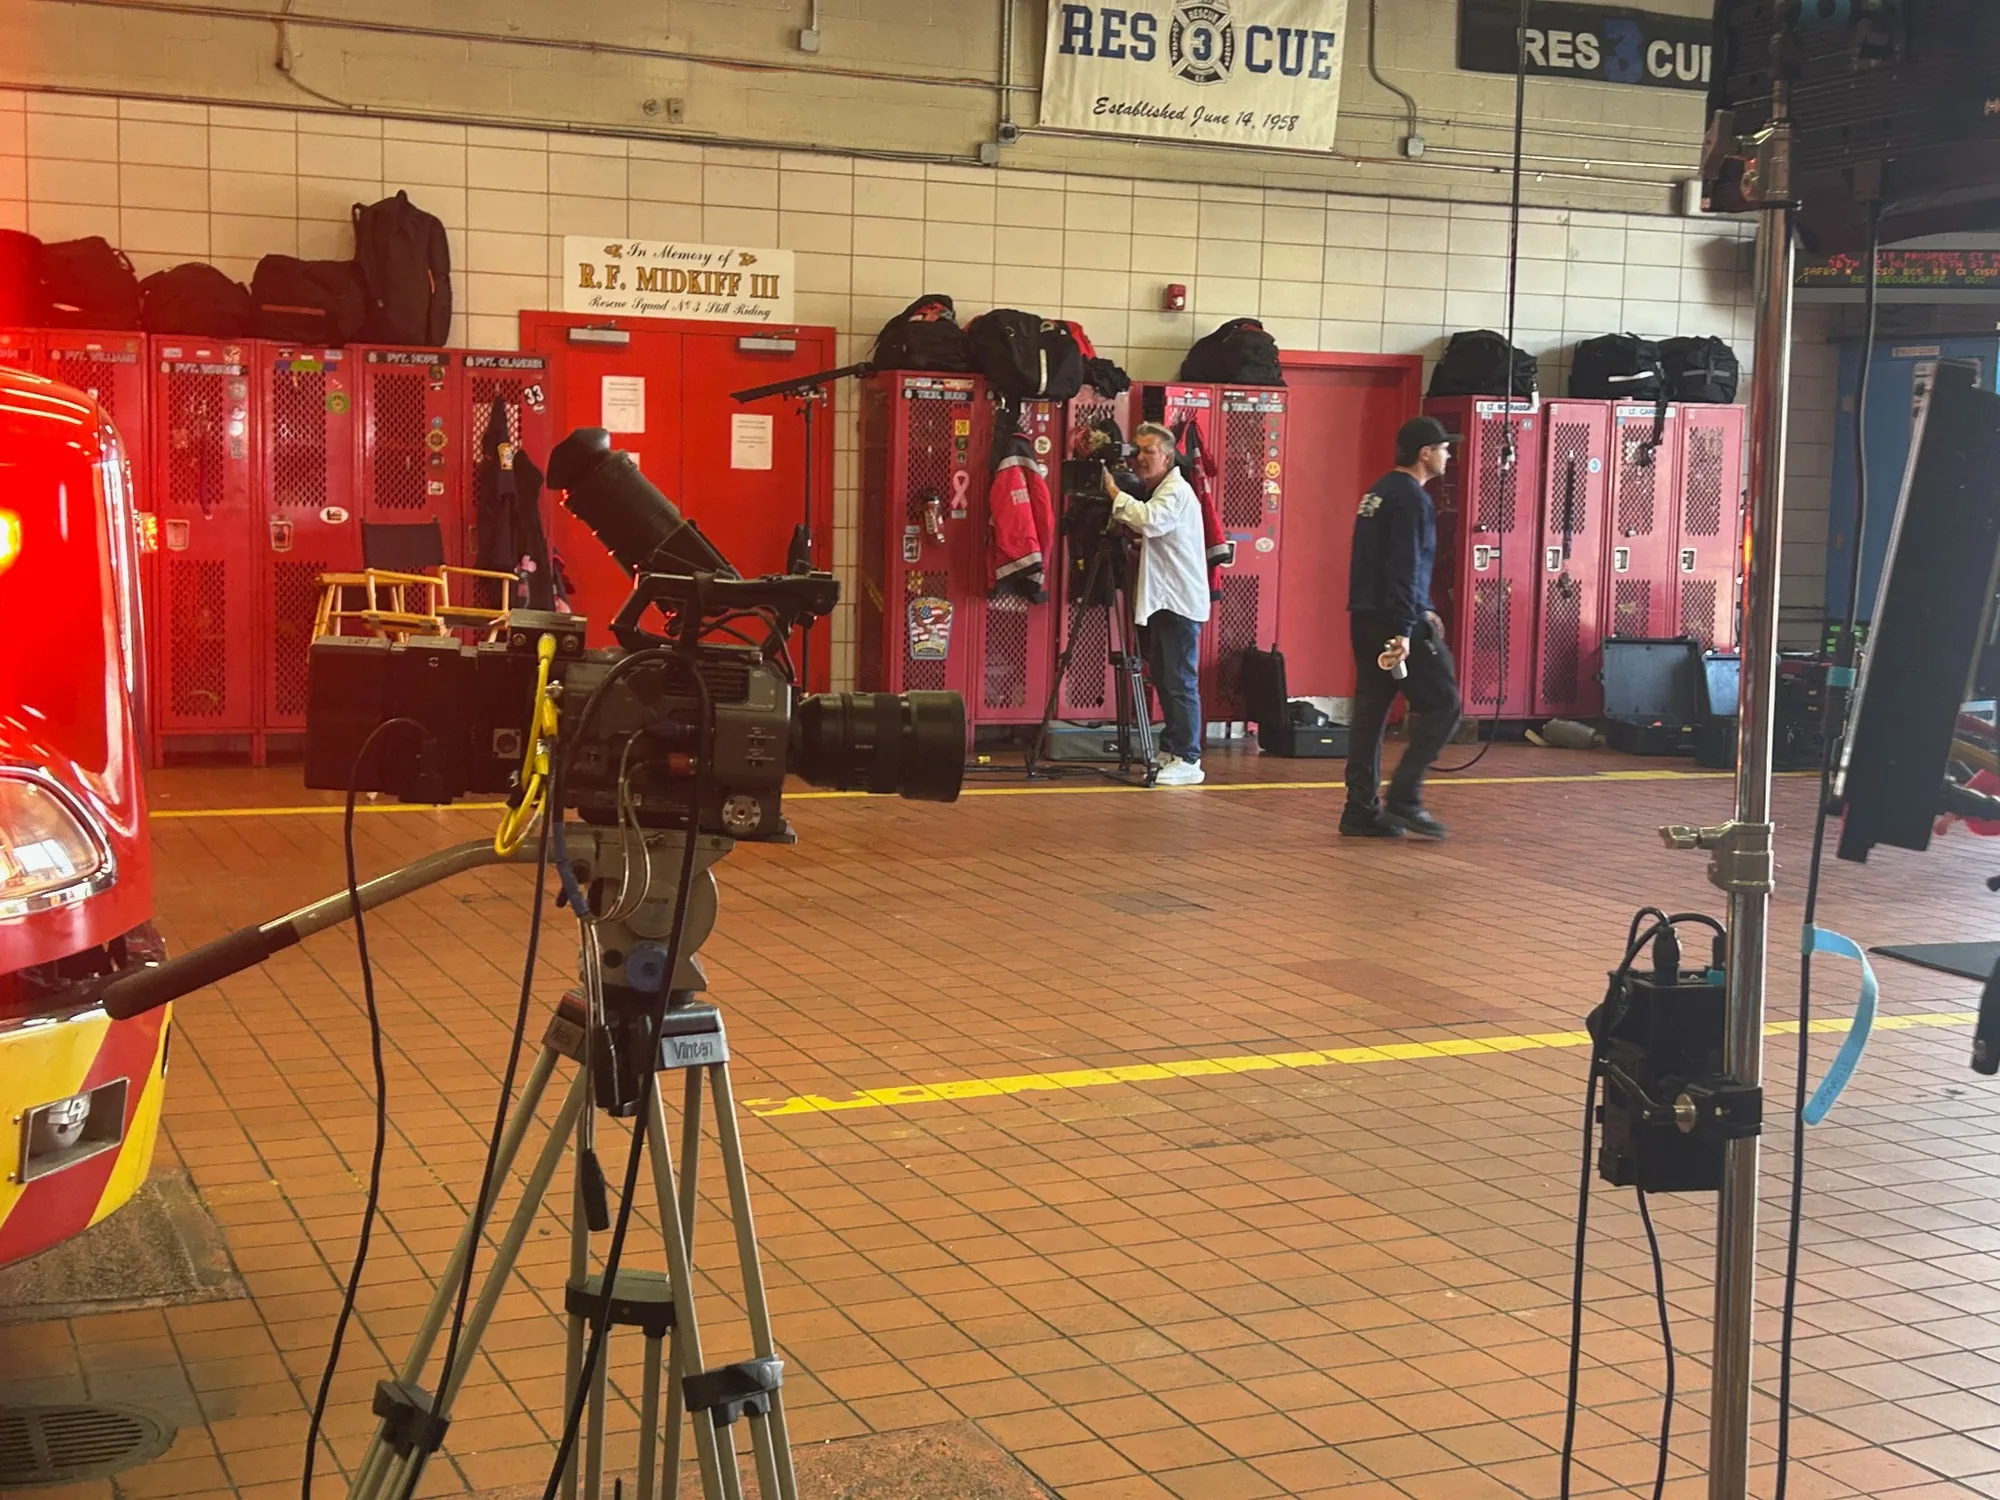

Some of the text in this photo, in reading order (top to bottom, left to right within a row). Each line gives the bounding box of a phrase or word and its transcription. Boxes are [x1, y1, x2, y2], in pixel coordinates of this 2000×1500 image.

[1187, 8, 1219, 23] RESCUE
[1059, 4, 1335, 80] RES 3 CUE
[1517, 28, 1600, 69] RES
[1604, 19, 1643, 82] 3
[1093, 97, 1186, 121] Established
[1192, 105, 1229, 128] June
[1263, 113, 1299, 131] 1958
[627, 242, 733, 267] In Memory of
[579, 263, 779, 299] R.F. MIDKIFF III
[588, 295, 627, 308] Rescue
[632, 297, 669, 313] Squad
[692, 302, 700, 313] 3
[705, 302, 731, 315] Still
[733, 303, 772, 320] Riding
[524, 384, 544, 404] 33
[673, 1041, 713, 1060] Vinten
